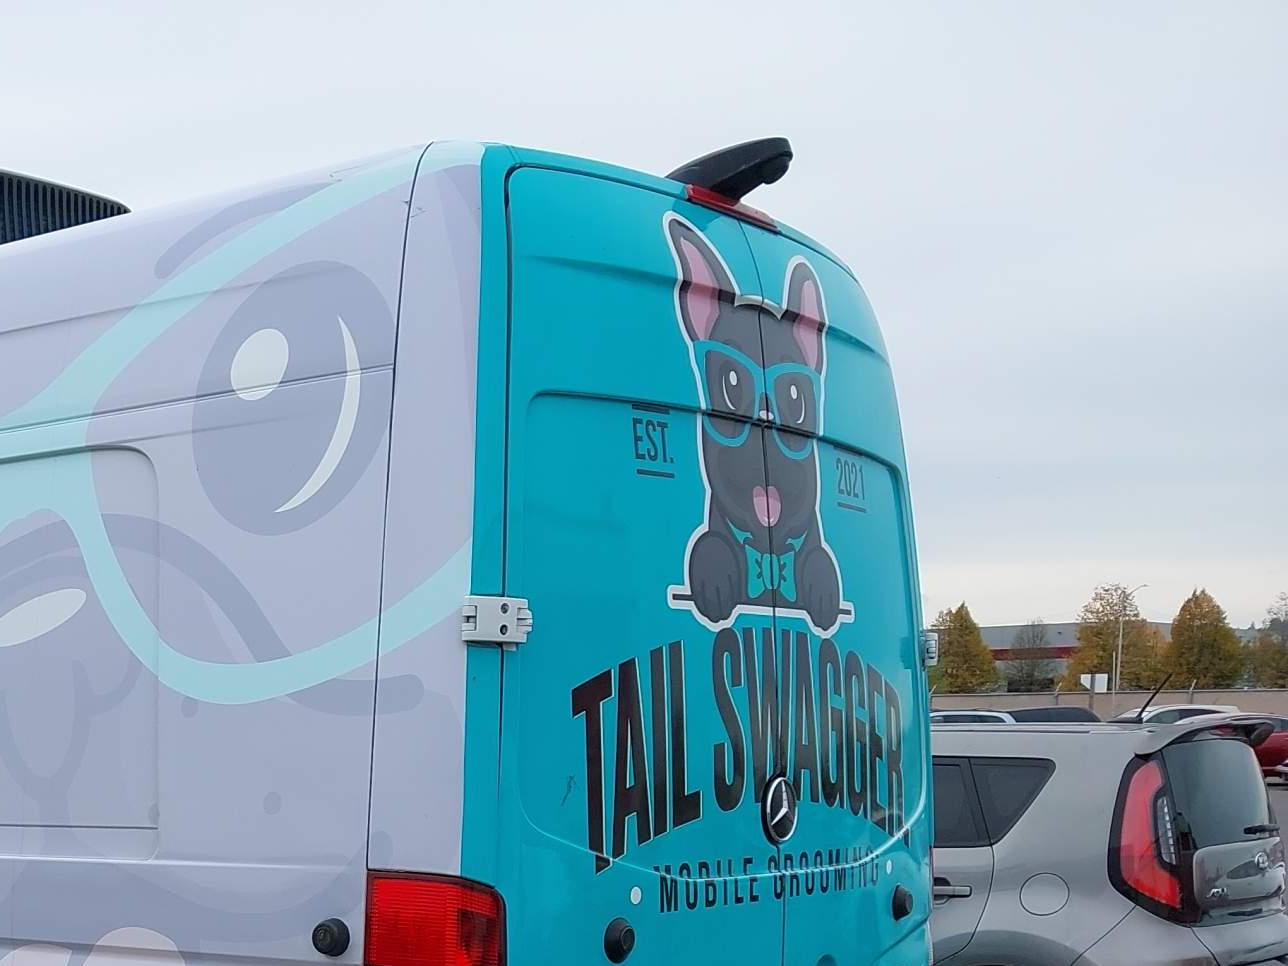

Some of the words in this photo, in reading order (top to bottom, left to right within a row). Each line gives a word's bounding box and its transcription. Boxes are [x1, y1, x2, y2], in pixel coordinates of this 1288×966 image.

[633, 417, 675, 464] EST.
[836, 457, 865, 501] 2021
[571, 640, 703, 876] TAIL
[714, 627, 909, 846] SWAGGER
[653, 857, 759, 914] MOBILE
[767, 845, 880, 900] GROOMING
